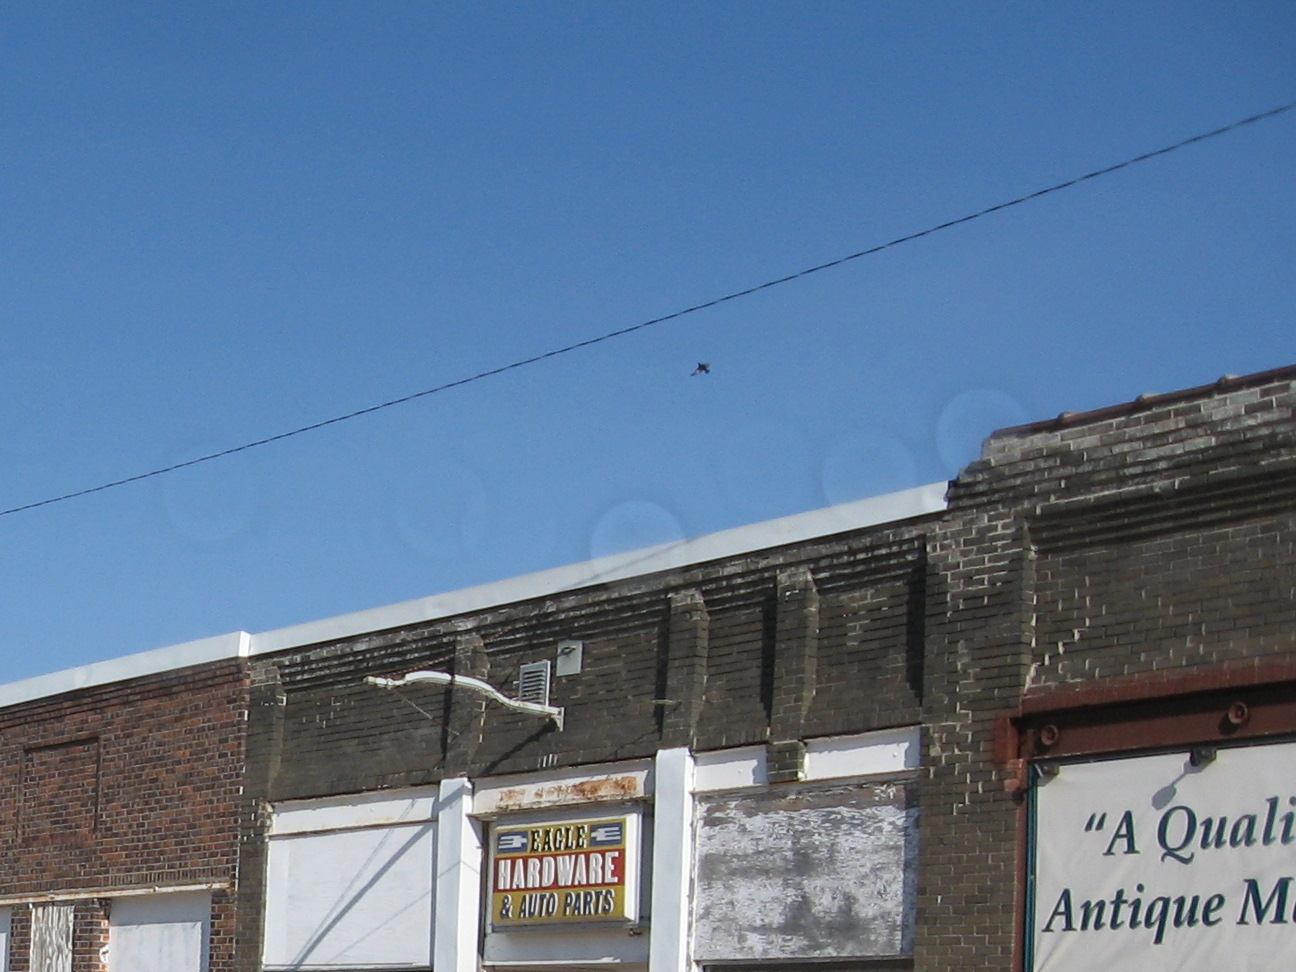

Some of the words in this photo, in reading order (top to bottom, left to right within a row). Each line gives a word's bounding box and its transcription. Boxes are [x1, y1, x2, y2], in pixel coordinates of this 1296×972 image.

[530, 825, 588, 852] EAGLE
[497, 851, 619, 890] HARDWARE
[500, 894, 513, 919] &
[519, 892, 559, 918] AUTO
[564, 888, 615, 917] PARTS
[1041, 883, 1226, 944] Antique
[1236, 877, 1296, 925] M
